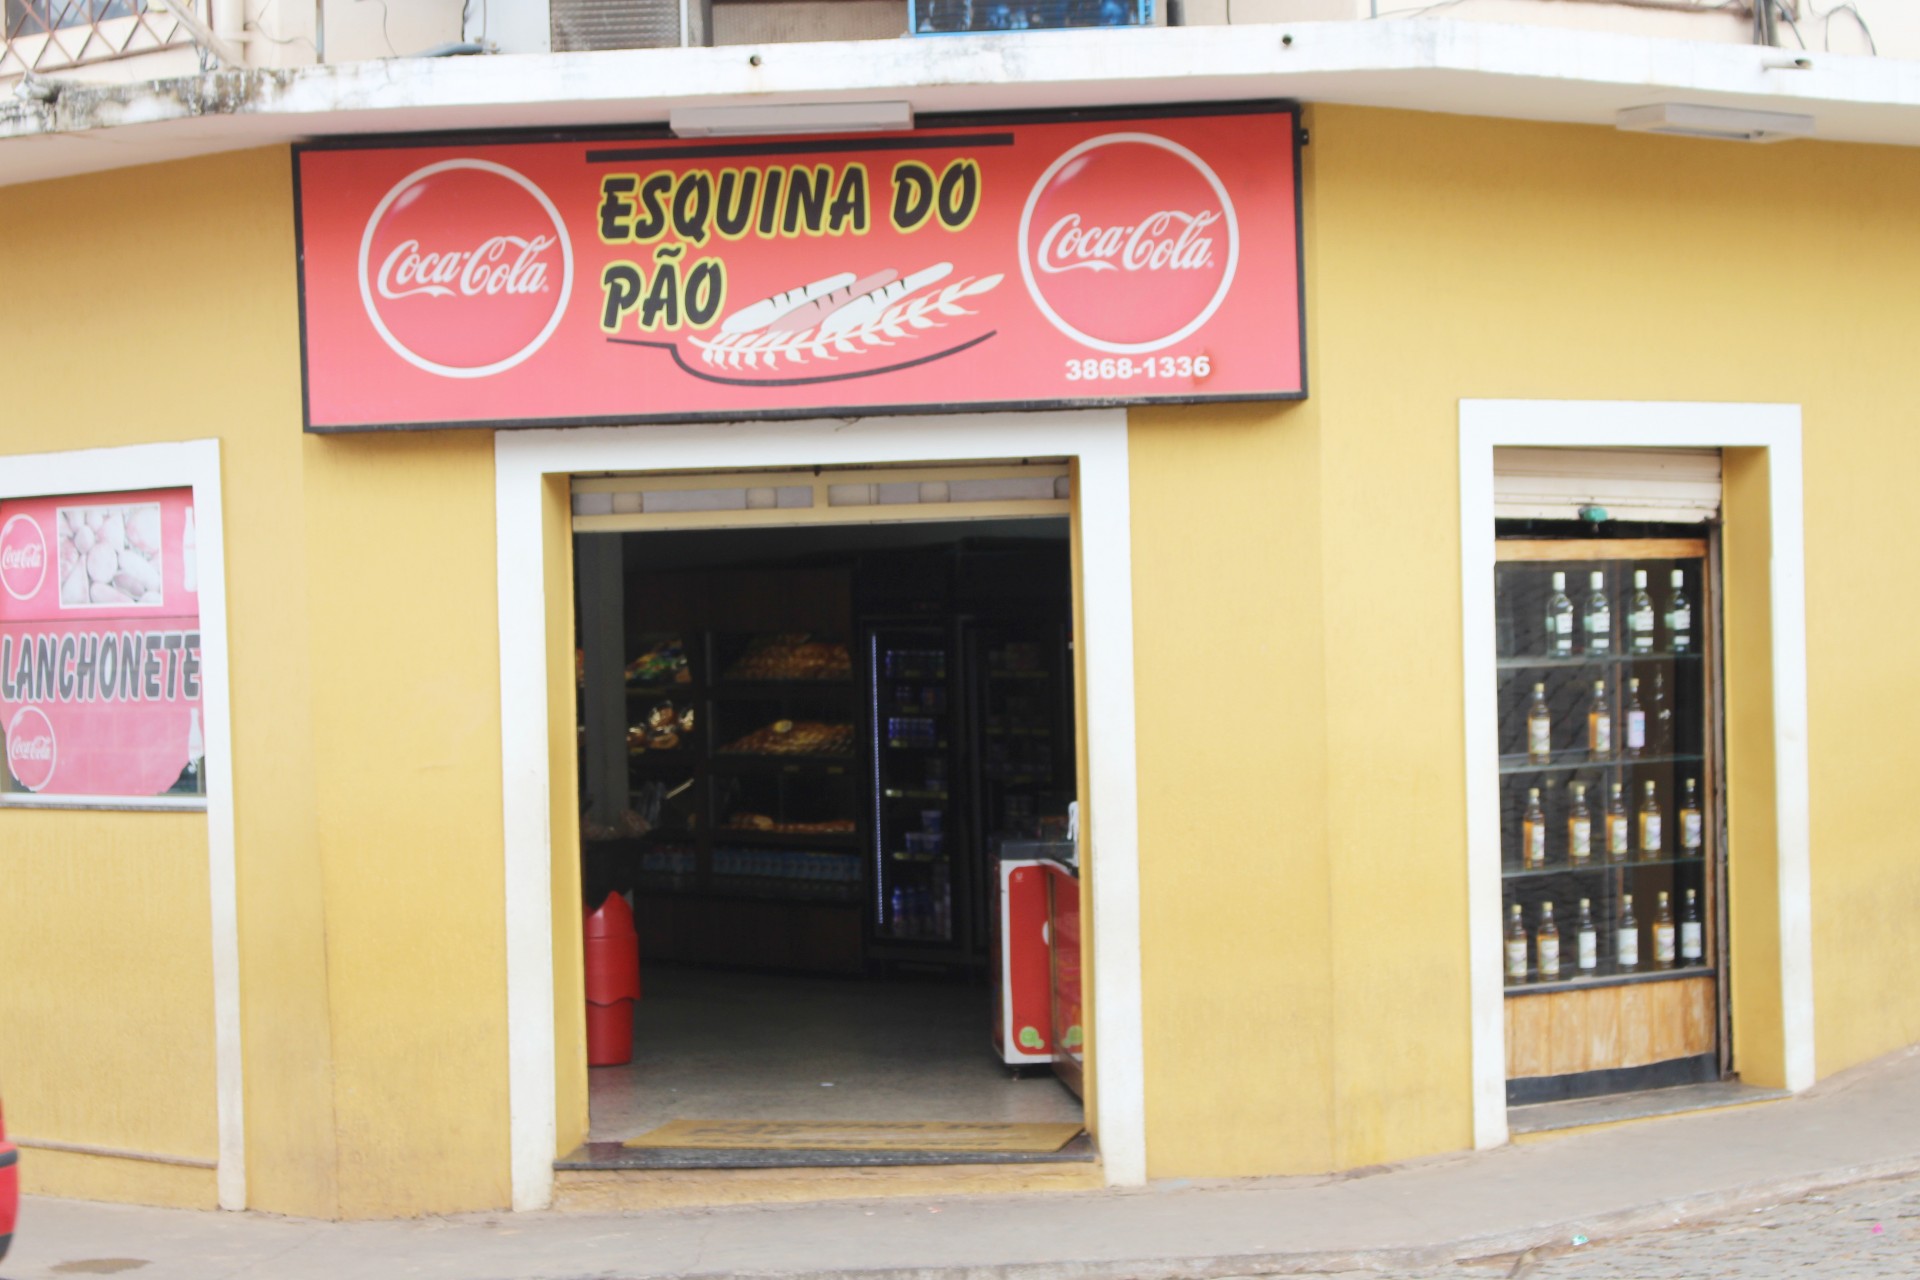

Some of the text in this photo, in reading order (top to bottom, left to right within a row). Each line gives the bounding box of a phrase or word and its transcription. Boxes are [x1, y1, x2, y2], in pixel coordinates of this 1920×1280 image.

[598, 157, 982, 248] ESQUINA DO
[376, 234, 557, 300] Coca-Cola
[1037, 209, 1222, 273] Coca-Cola
[600, 242, 728, 334] PÃO
[1064, 355, 1211, 381] 3868-1336
[2, 543, 42, 571] Coca-Cola
[1, 632, 200, 702] LANCHONETE
